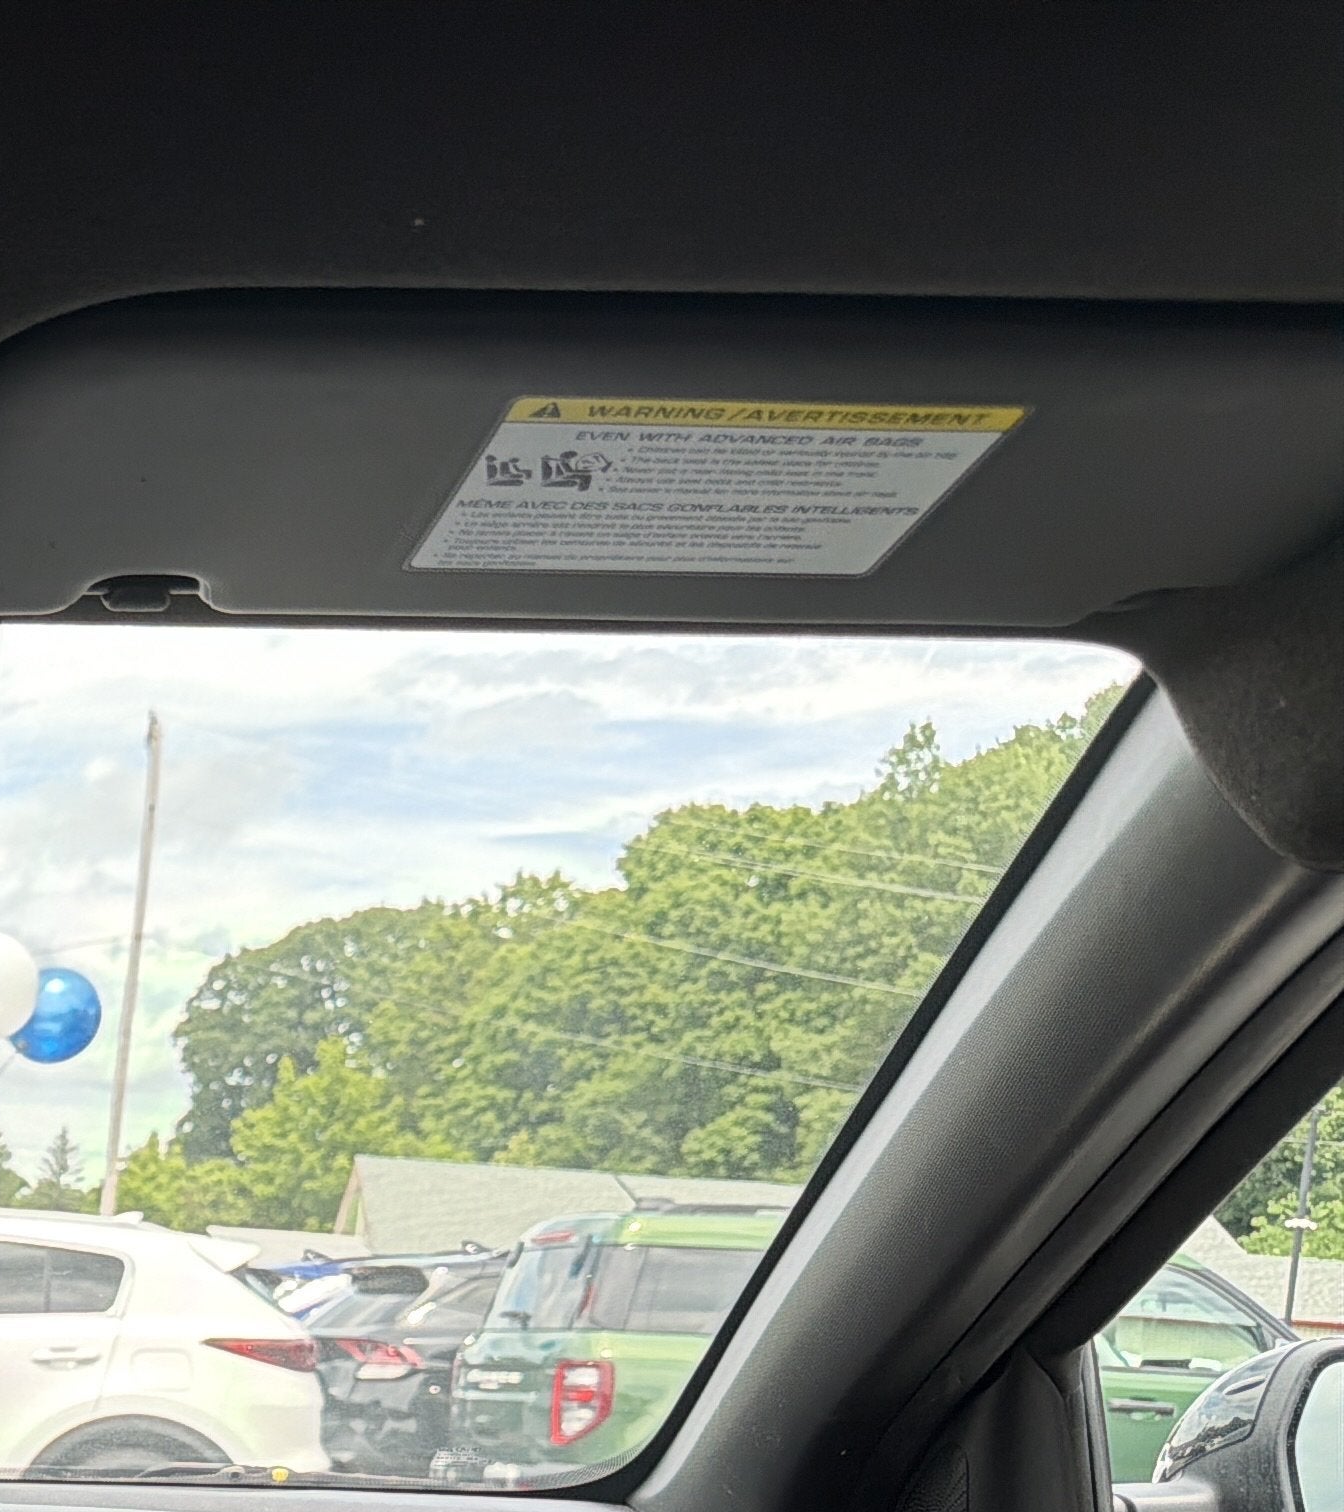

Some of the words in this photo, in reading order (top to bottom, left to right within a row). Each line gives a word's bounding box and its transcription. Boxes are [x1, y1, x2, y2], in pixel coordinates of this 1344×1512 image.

[575, 431, 631, 442] EVEN
[638, 432, 692, 443] WITH
[698, 433, 814, 445] ADVANCED
[819, 435, 856, 446] AIR
[863, 436, 925, 448] BAGS
